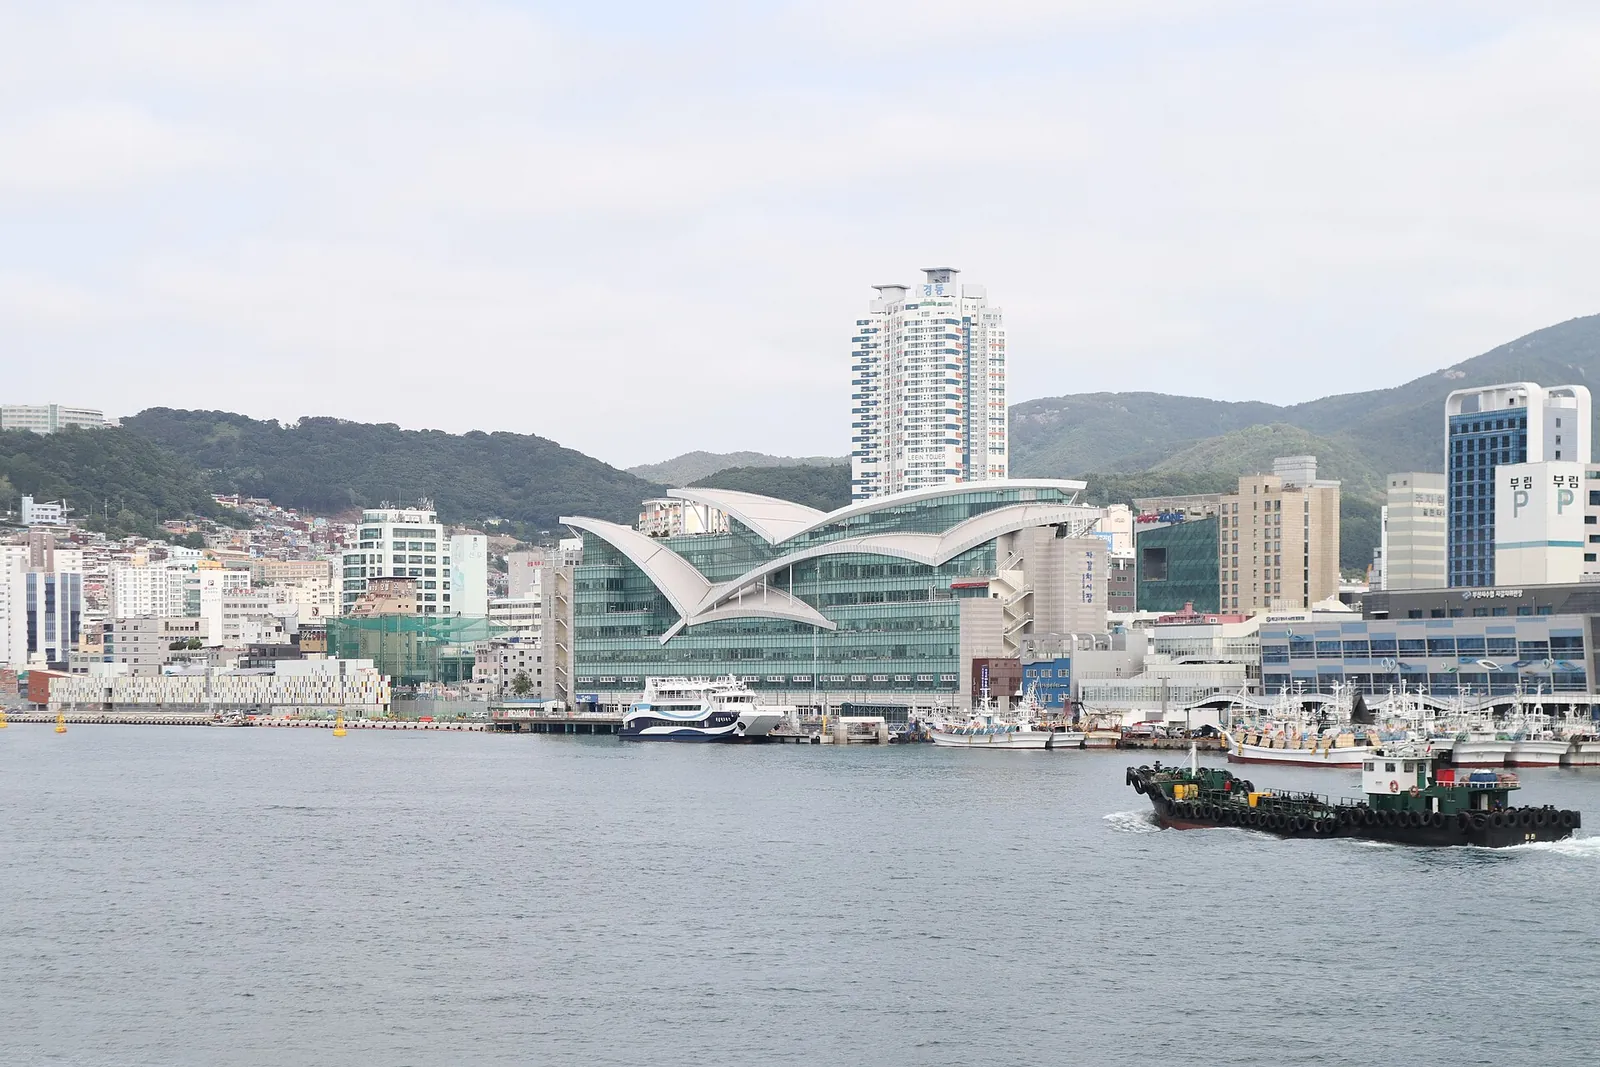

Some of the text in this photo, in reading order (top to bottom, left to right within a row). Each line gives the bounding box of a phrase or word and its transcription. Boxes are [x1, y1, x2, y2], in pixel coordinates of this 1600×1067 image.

[923, 284, 944, 297] 경동
[1510, 476, 1532, 490] 부림
[1553, 475, 1579, 489] 부림
[1513, 490, 1529, 518] P
[1557, 489, 1574, 515] P
[1158, 512, 1184, 524] ZONE
[1085, 551, 1093, 604] 자갈치시장
